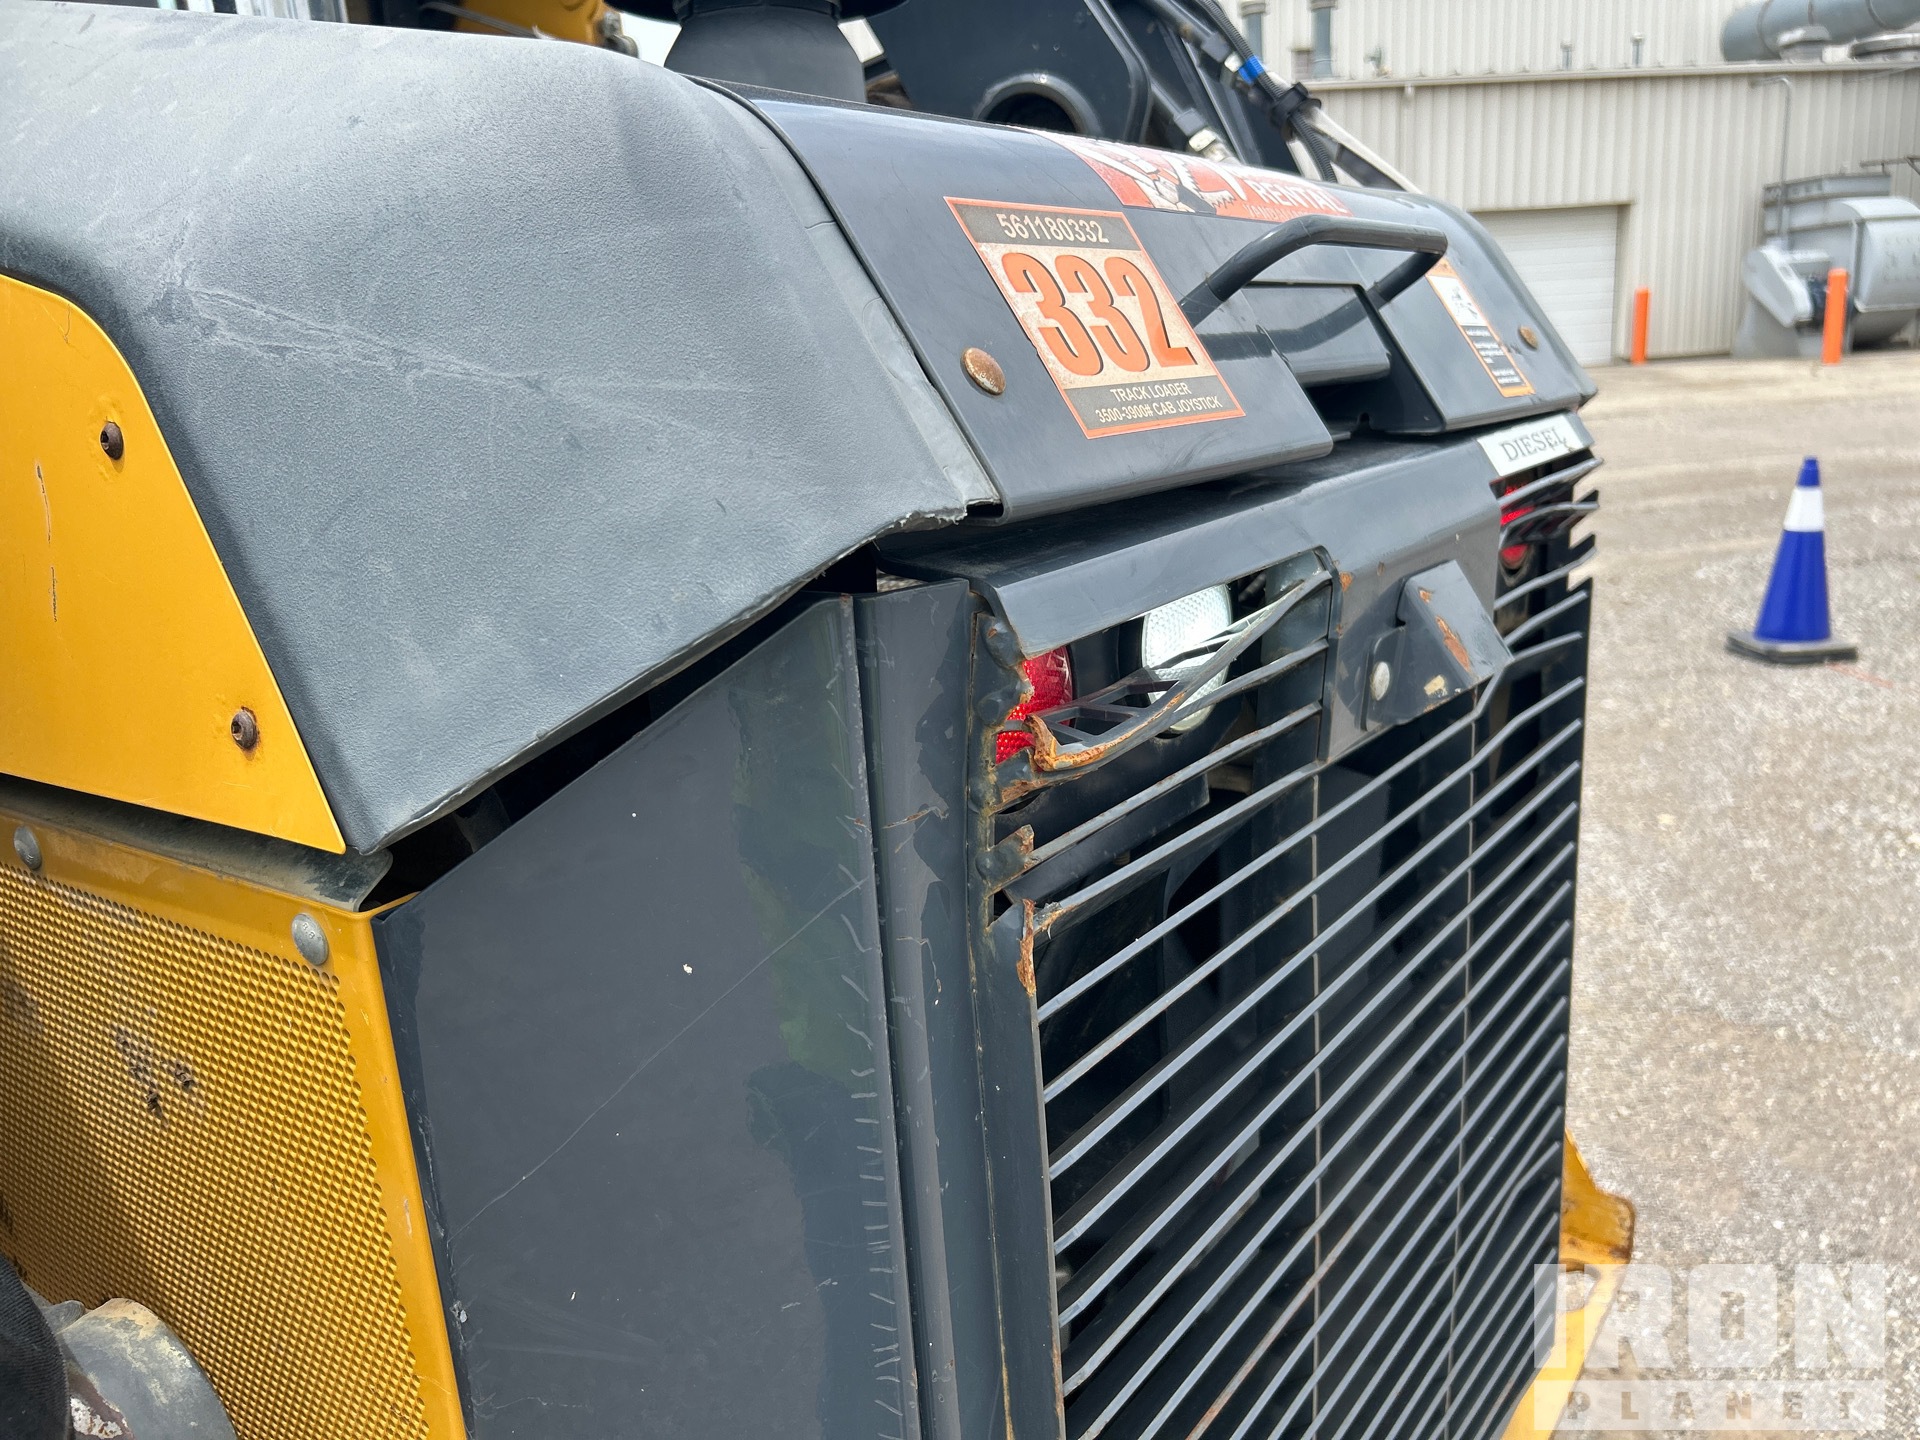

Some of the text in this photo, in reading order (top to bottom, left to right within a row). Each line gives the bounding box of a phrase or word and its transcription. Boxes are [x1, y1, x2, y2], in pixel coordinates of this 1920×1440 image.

[1244, 180, 1348, 214] RENTAL
[996, 213, 1109, 243] 561180332
[1001, 252, 1198, 376] 332
[1110, 382, 1192, 402] TRACK LOADER
[1095, 395, 1223, 423] 3500-3900# CAB JOYSTICK
[1499, 427, 1567, 462] DIESEL
